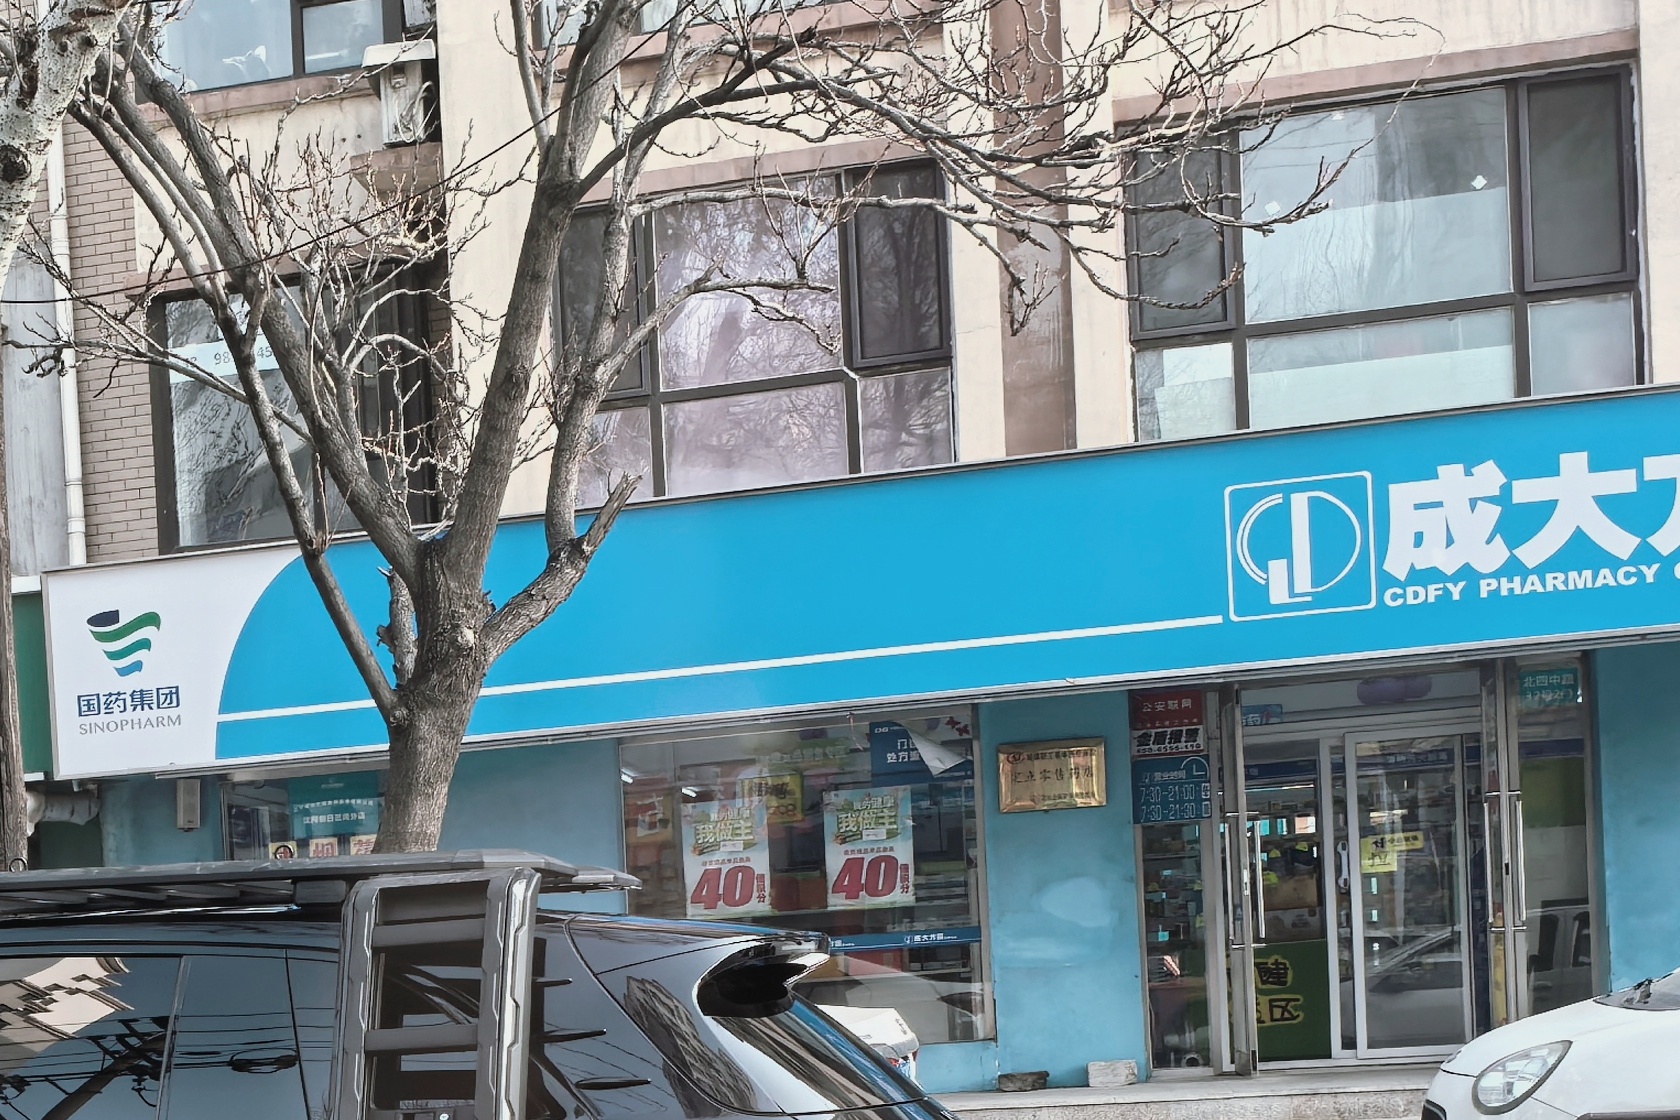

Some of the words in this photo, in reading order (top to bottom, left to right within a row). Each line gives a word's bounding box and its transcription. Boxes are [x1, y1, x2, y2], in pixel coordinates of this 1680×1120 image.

[1383, 581, 1467, 607] CDFY
[1479, 563, 1661, 599] PHARMACY
[77, 685, 181, 717] 国药集团
[79, 714, 182, 735] SINOPHARM
[690, 865, 756, 909] 40
[832, 855, 899, 899] 40
